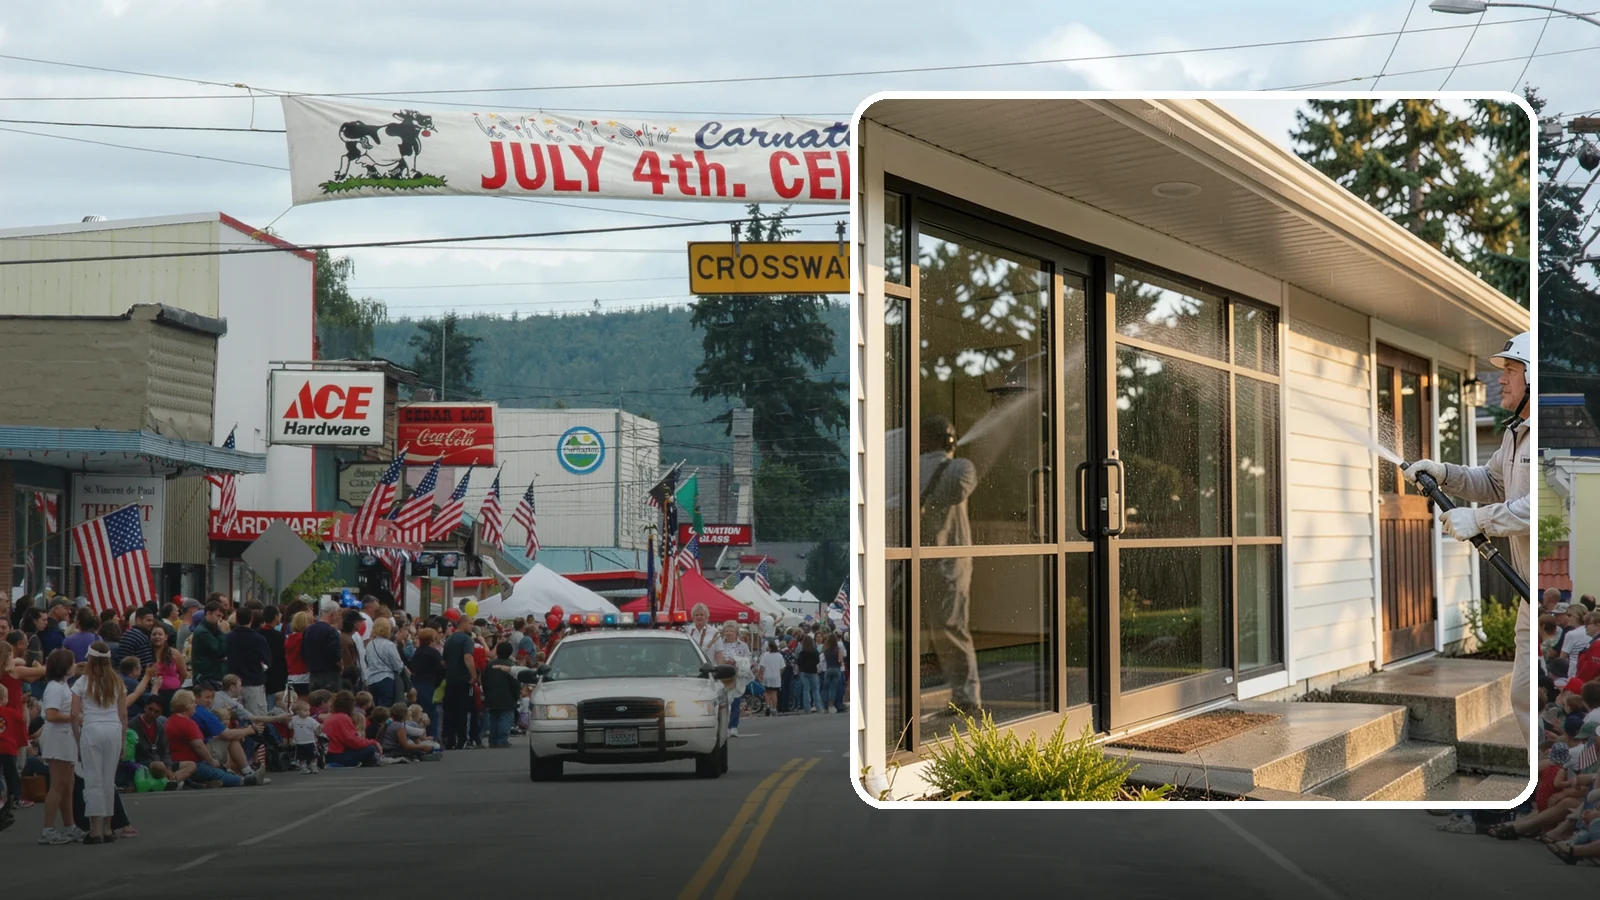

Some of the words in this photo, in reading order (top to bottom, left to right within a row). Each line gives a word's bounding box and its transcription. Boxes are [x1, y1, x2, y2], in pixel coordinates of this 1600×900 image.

[694, 121, 850, 149] Carnat
[481, 141, 604, 192] JULY
[632, 150, 746, 197] 4th.
[696, 254, 850, 280] CROSSWA
[282, 380, 374, 420] ACE
[406, 409, 452, 422] CEDAR
[461, 410, 485, 421] LOG
[283, 421, 371, 436] Hardware
[416, 428, 477, 447] Coca-Cola
[353, 467, 389, 480] Simpl
[83, 485, 93, 494] St.
[96, 485, 124, 495] Vincent
[126, 486, 136, 495] de
[137, 486, 155, 495] Paul
[81, 503, 153, 522] THT
[213, 517, 330, 536] HARDARE
[688, 526, 741, 535] CRNATION
[699, 535, 730, 543] GLASS
